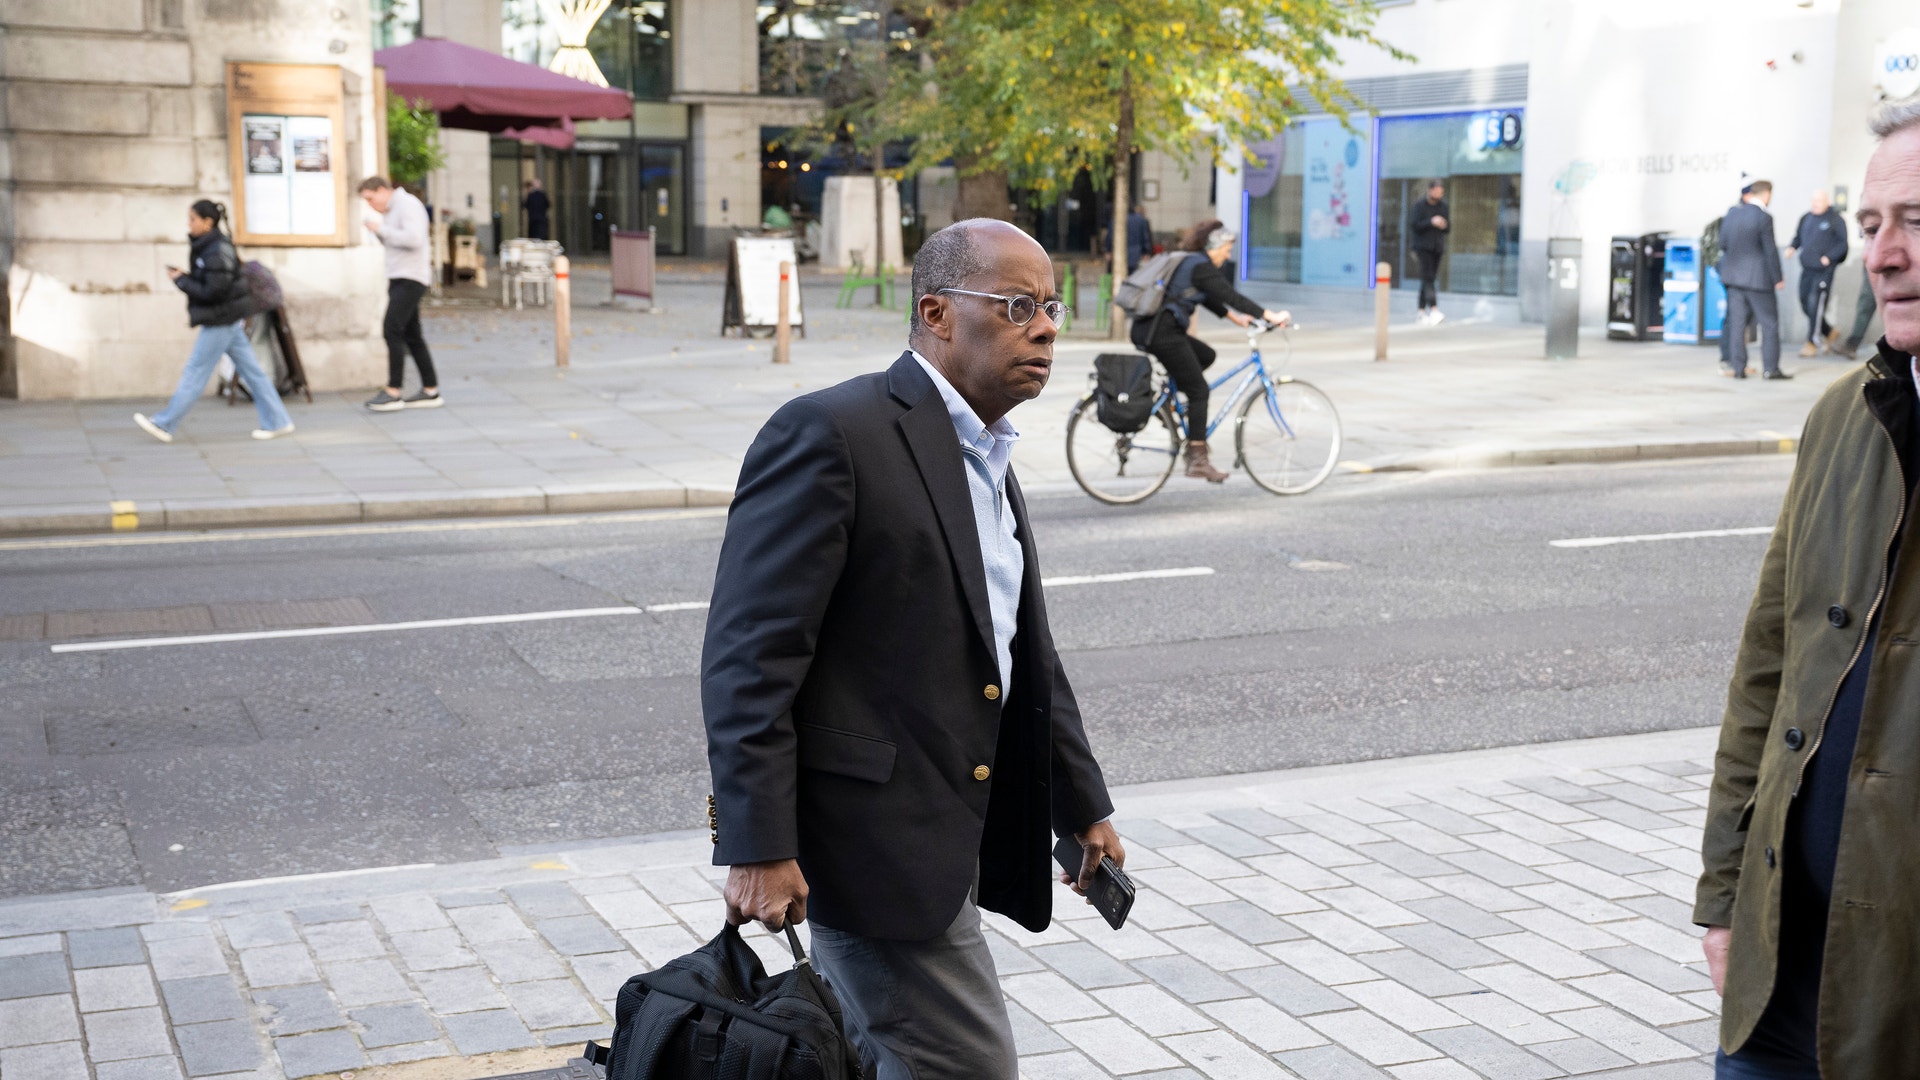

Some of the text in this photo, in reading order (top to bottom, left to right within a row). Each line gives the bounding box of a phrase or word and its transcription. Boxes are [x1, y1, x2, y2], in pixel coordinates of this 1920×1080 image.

[1470, 114, 1517, 144] SB
[1637, 154, 1675, 174] BELLS
[1679, 152, 1729, 173] HOUSE
